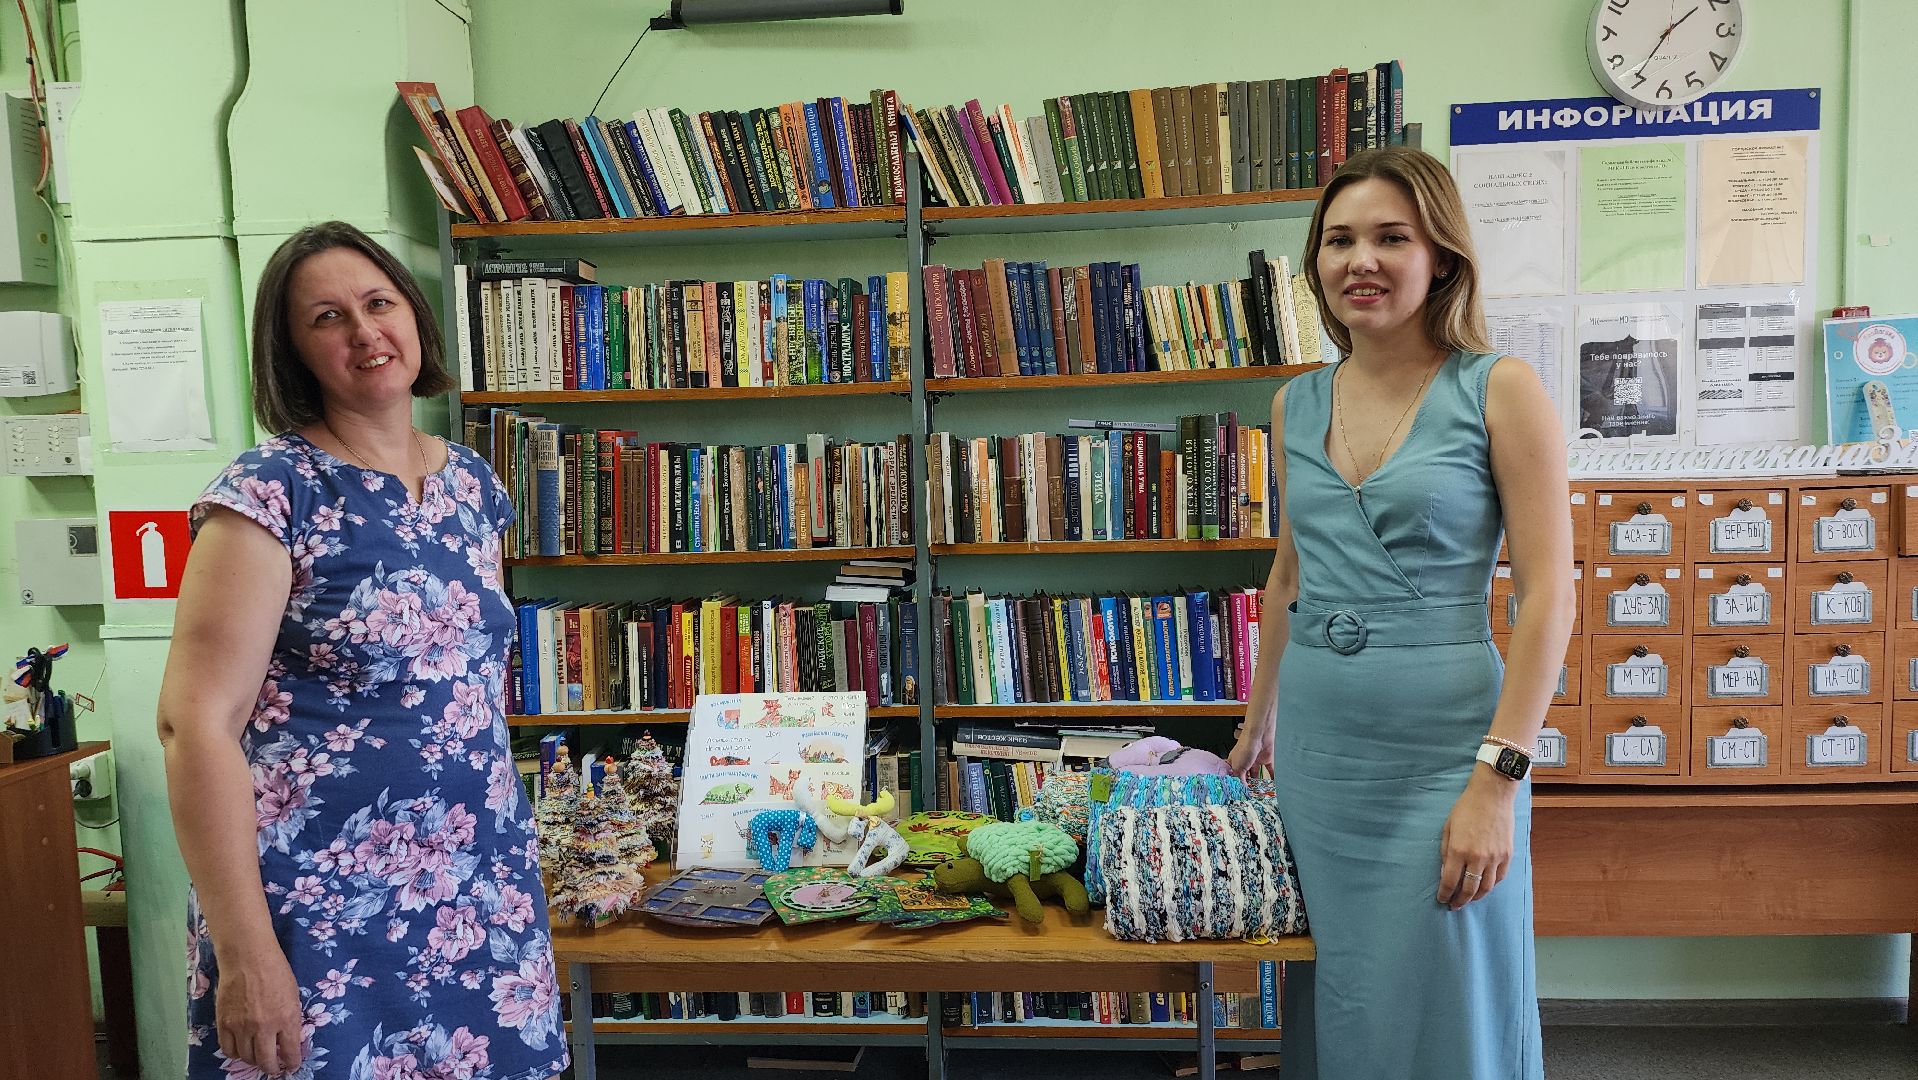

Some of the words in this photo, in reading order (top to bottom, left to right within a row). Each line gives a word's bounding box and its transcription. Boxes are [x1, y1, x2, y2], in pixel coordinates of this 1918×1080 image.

[1716, 22, 1736, 38] 3
[1607, 54, 1624, 70] 8
[1709, 51, 1727, 72] 4
[1656, 79, 1672, 99] 6
[1684, 71, 1704, 89] 5
[886, 96, 896, 127] КНИГА
[1394, 88, 1402, 134] ФИЛОСОФИЯ
[1498, 99, 1772, 131] ИНФОРМАЦИЯ
[807, 107, 823, 164] ПОДВИЖНИЦЫ
[756, 121, 776, 187] ДОКАЗАТЕЛЬСТВА
[889, 130, 904, 198] ПРАВОСЛАВНАЯ
[933, 272, 944, 322] ФИЛОСОФИЯ
[829, 324, 837, 348] ПЕСНЕЙ
[841, 323, 852, 376] НОСТРАДАМУС
[830, 350, 838, 370] ПЕСНЬ
[1590, 353, 1609, 361] Тебе
[1612, 352, 1668, 360] понравилось
[888, 445, 896, 479] ВОЗРАСТ
[1035, 438, 1045, 472] ЭТИКА
[1094, 471, 1103, 505] ЭТИКА
[1164, 467, 1172, 486] ЭТИКЕ
[1185, 439, 1195, 515] ПСИХОЛОГИЯ
[1204, 438, 1213, 515] ПСИХОЛОГИЯ
[889, 481, 897, 520] ЗРЕЛОСТИ
[1164, 495, 1172, 524] СЛОВАРЬ
[1725, 523, 1761, 540] БЕР-БЫ
[1235, 598, 1243, 639] ПСИХОАНАЛИЗА
[1105, 609, 1118, 662] ПСИХОЛОГИЯ
[1124, 625, 1132, 662] психологии
[1723, 671, 1759, 687] МЕР-НА
[977, 734, 1007, 742] жестов
[1009, 736, 1027, 744] язык
[1263, 961, 1273, 994] ФЕНОМЕН
